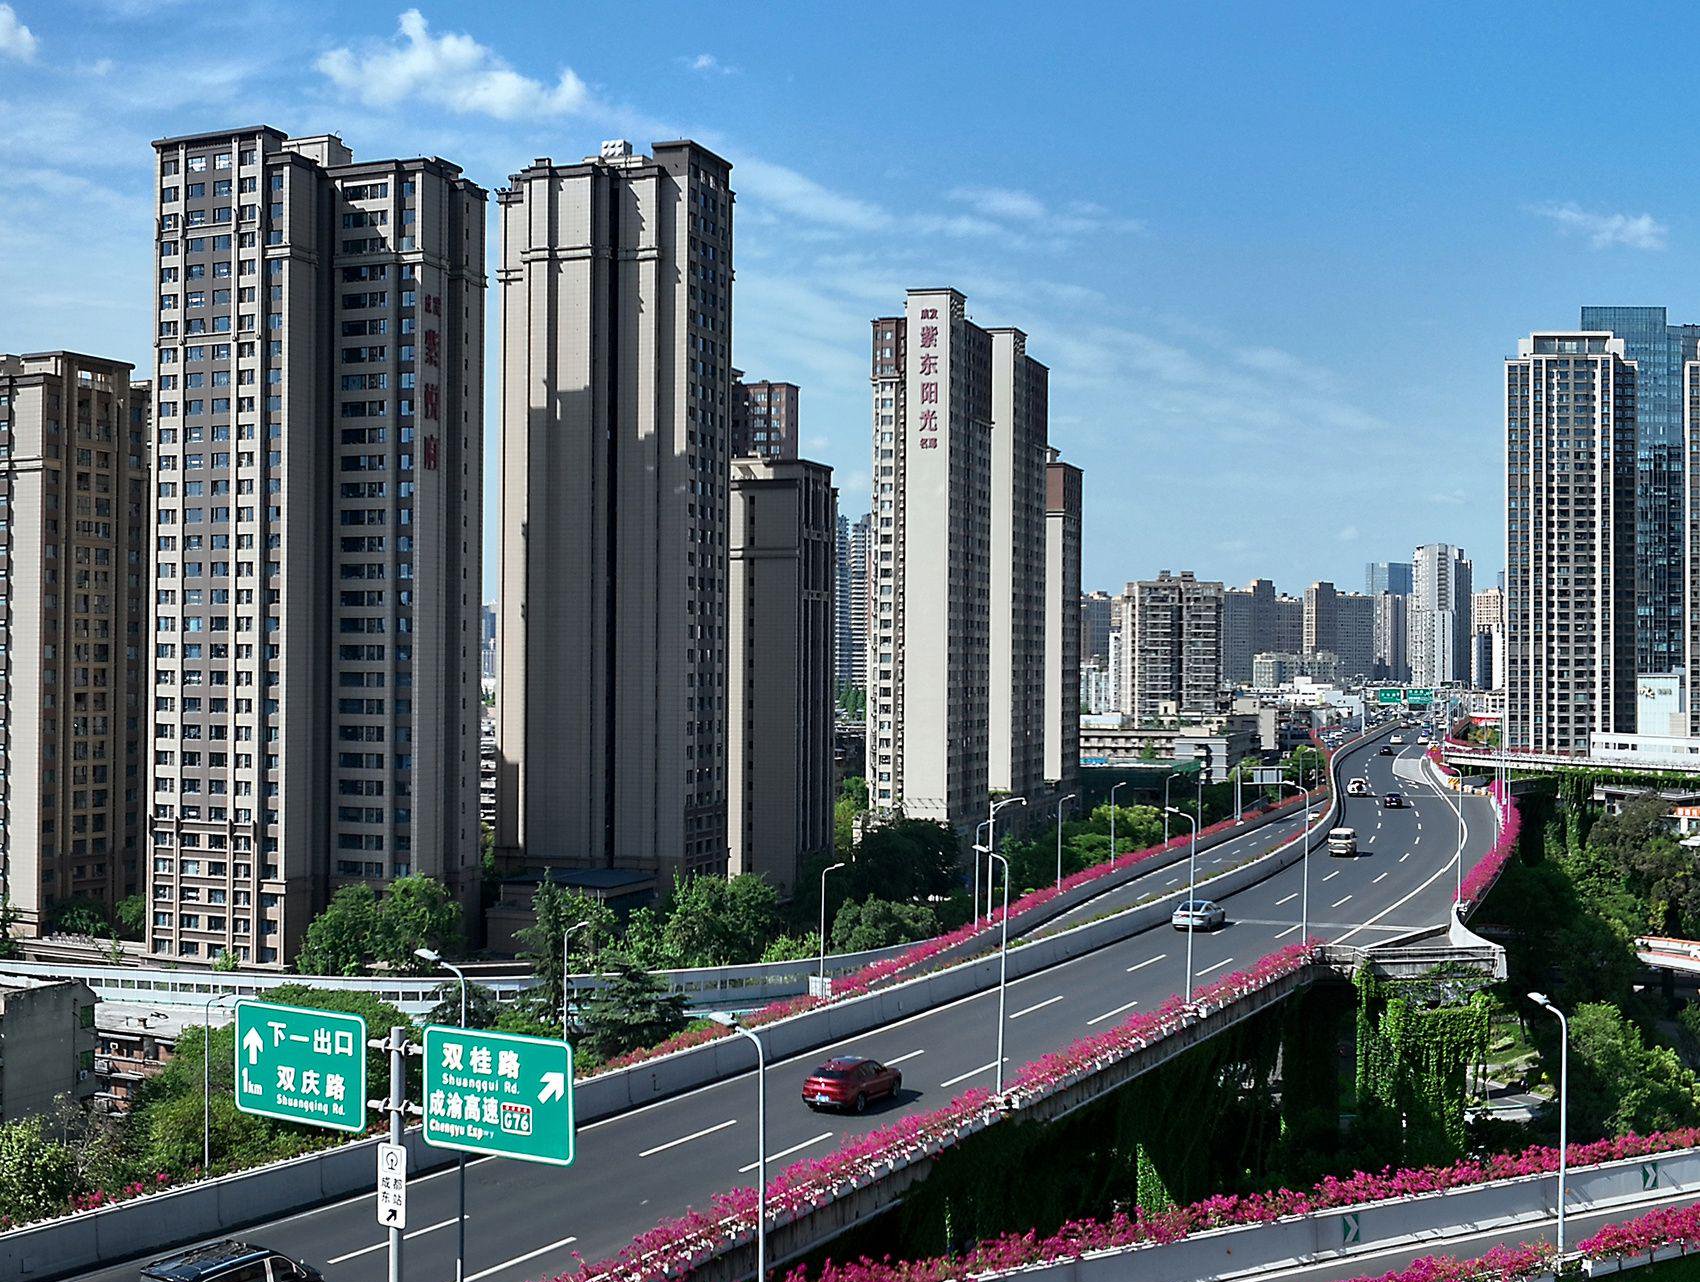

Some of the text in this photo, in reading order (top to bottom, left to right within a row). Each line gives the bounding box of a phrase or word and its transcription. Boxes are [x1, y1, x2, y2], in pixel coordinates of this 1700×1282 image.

[266, 1021, 354, 1056] 下一出口
[441, 1042, 520, 1079] 双桂路
[275, 1065, 346, 1101] 双庆路
[441, 1072, 520, 1095] Shuanggui Rd.
[276, 1093, 346, 1116] Shuangqing Rd.
[429, 1089, 500, 1125] 成渝高速
[504, 1112, 529, 1131] G76
[381, 1176, 403, 1191] 成都
[381, 1191, 402, 1207] 东站
